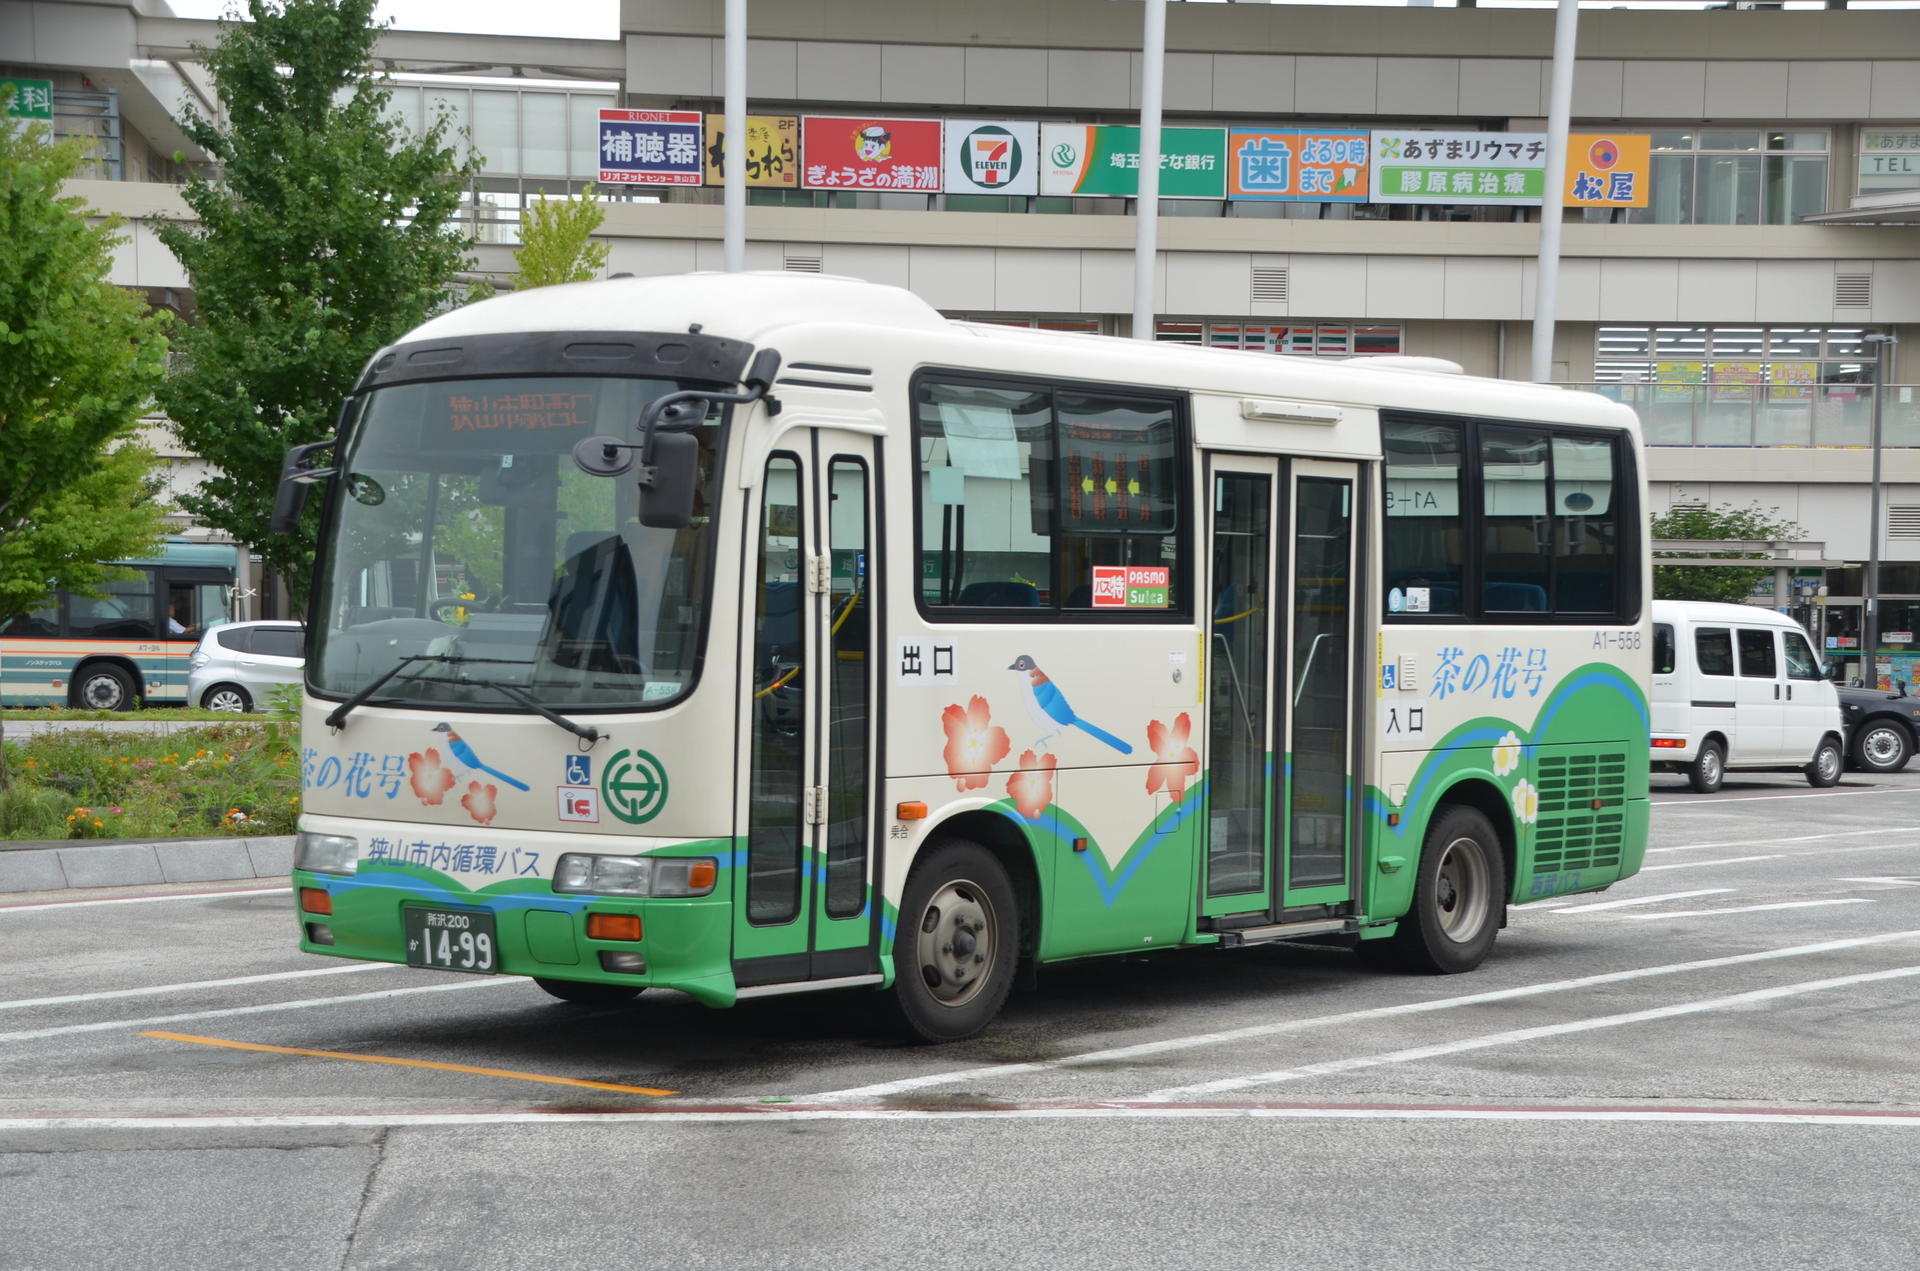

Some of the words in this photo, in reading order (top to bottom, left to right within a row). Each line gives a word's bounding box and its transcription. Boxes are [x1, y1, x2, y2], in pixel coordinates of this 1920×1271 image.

[629, 111, 671, 122] RIONET
[778, 120, 795, 130] 2F
[602, 130, 697, 164] 補聴器
[1300, 138, 1367, 166] よる9時
[1402, 138, 1545, 160] あずまリウマチ
[1110, 152, 1216, 170] 埼玉そな銀行
[1238, 137, 1290, 193] 歯
[1873, 157, 1912, 172] TEL
[807, 165, 938, 189] ぎょうざの満洲
[1300, 168, 1334, 193] まで
[1400, 170, 1526, 194] 膠原病治療
[1572, 172, 1634, 202] 松屋
[1129, 571, 1165, 584] PASMO
[1130, 590, 1163, 604] Suica
[1593, 632, 1641, 650] A1-558
[902, 645, 953, 677] 出口
[1429, 647, 1548, 700] 茶の花号
[1387, 707, 1423, 733] 入口
[368, 837, 541, 876] 狭山市内循環バス
[423, 927, 493, 970] 14-99
